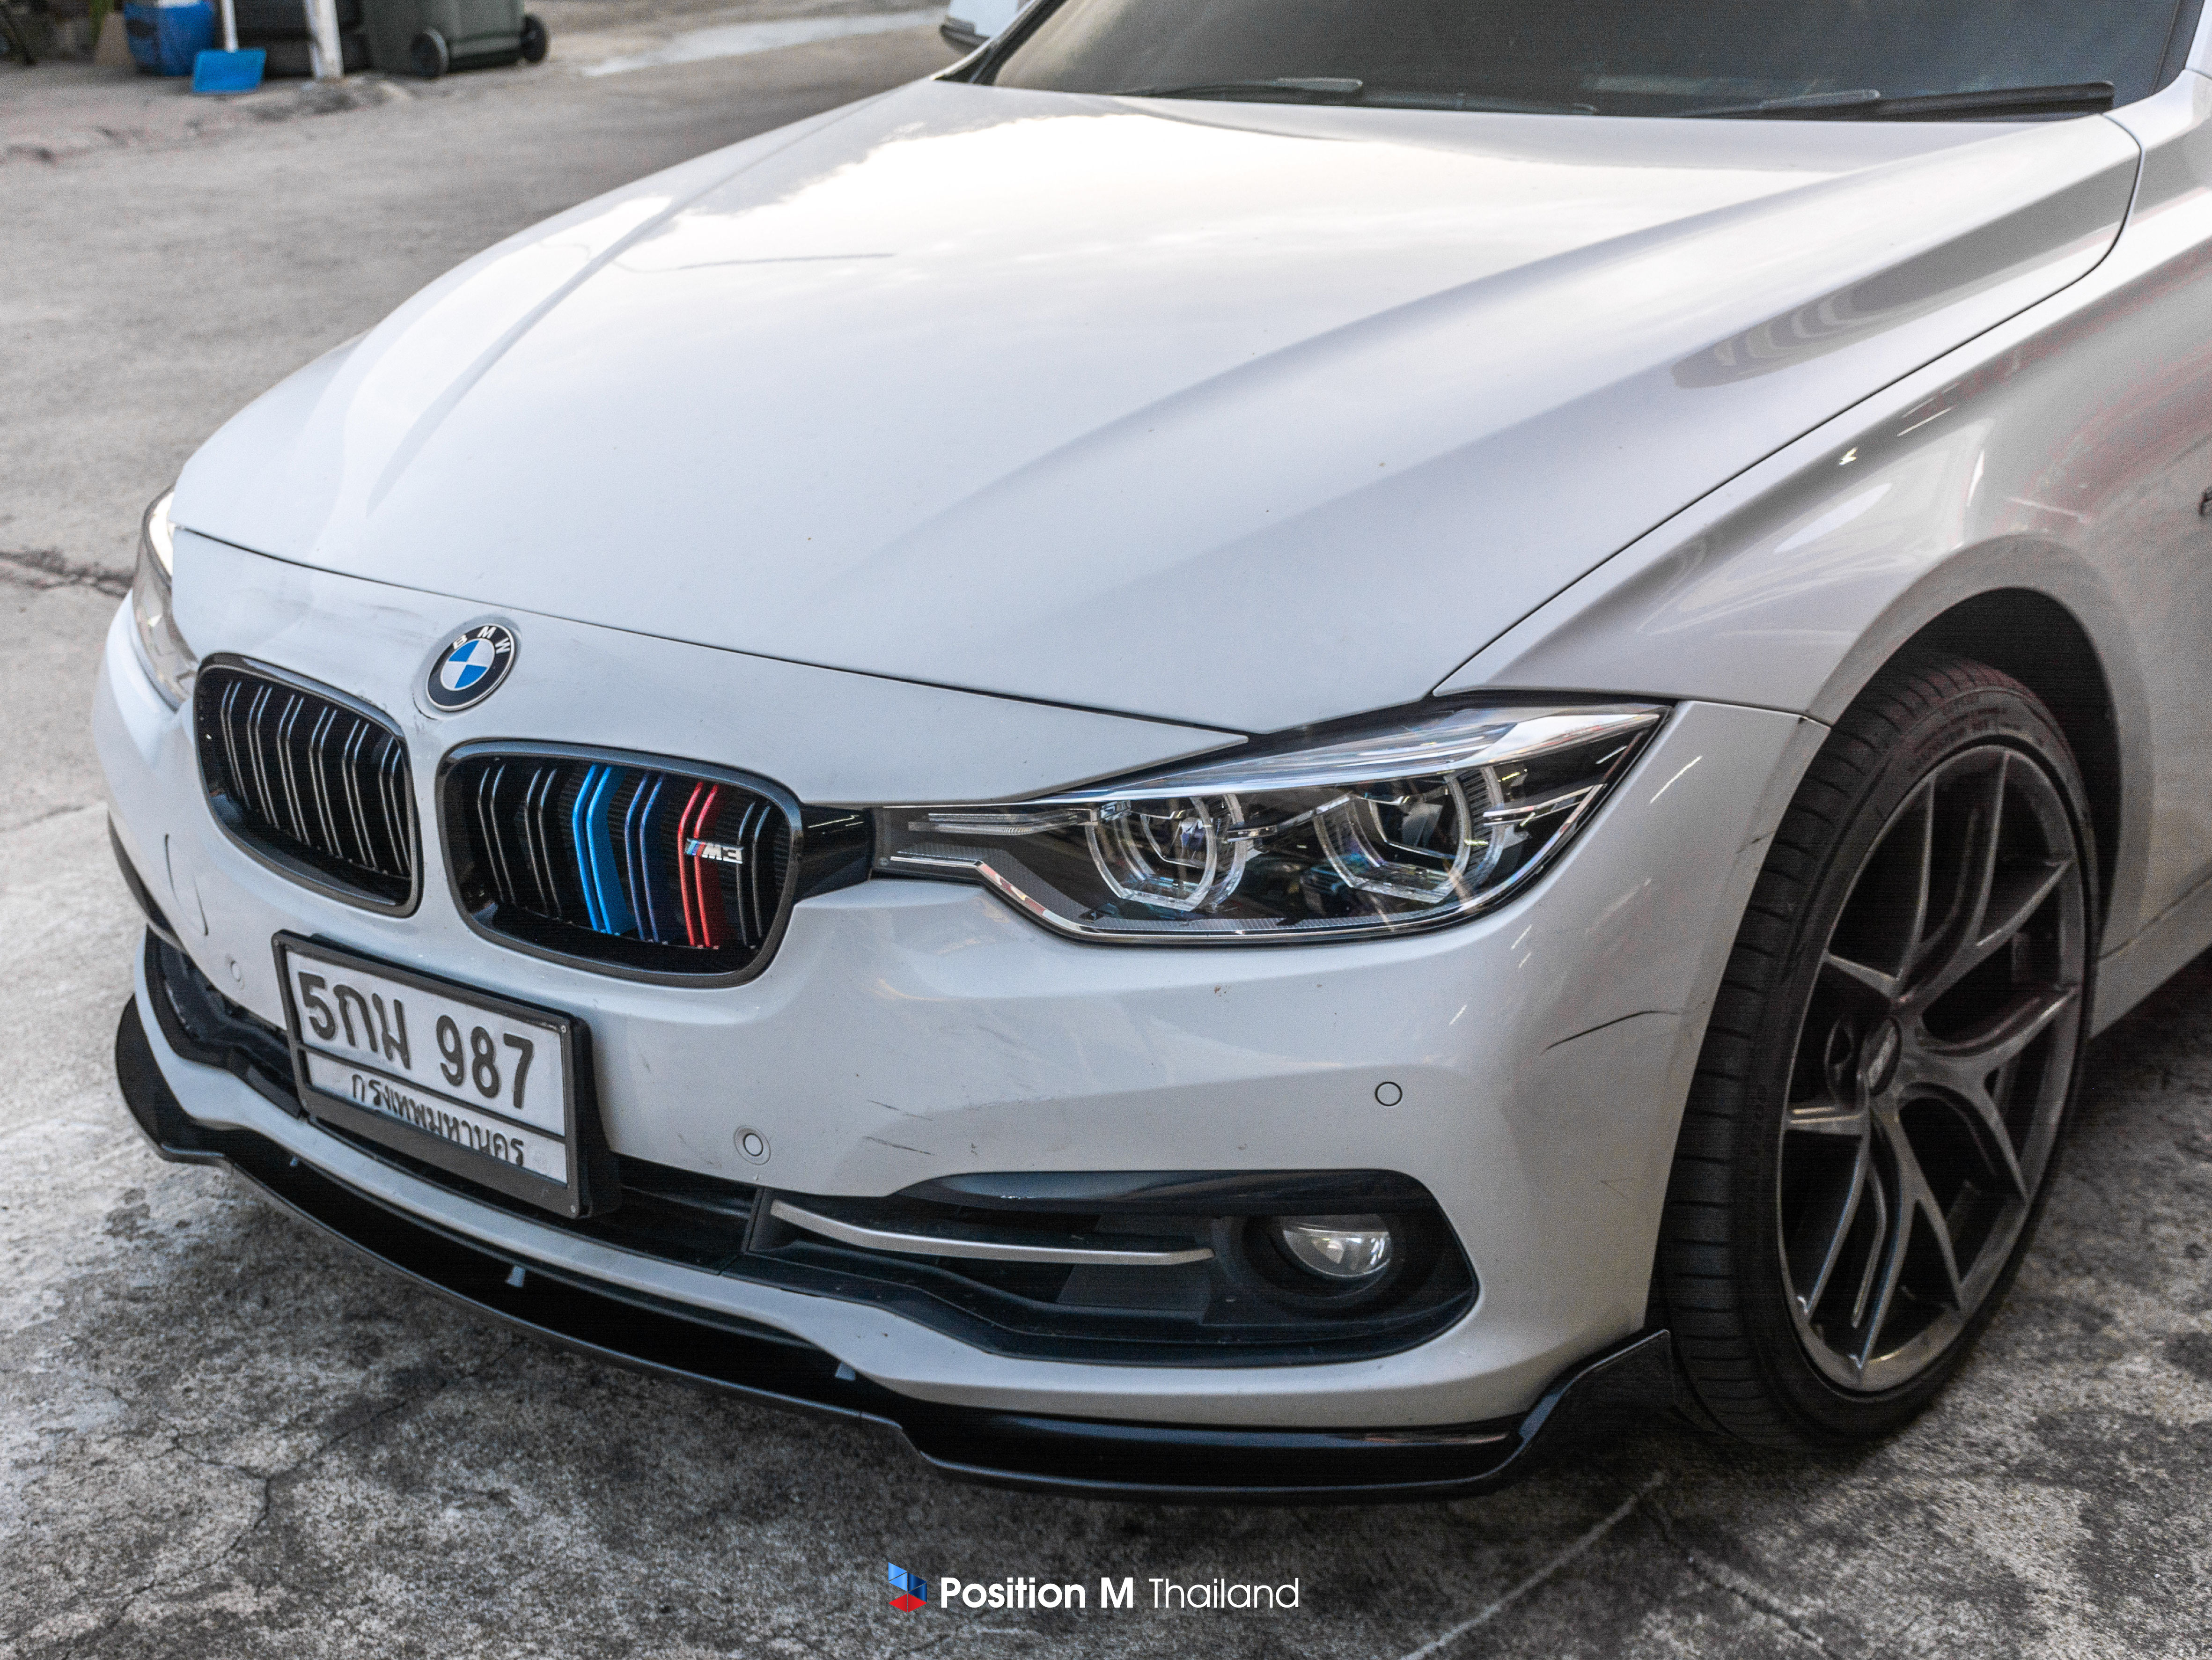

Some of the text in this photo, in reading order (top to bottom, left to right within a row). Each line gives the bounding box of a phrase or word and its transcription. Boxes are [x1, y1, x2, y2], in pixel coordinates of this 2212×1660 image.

[453, 626, 511, 654] BMW
[701, 842, 743, 864] M3
[436, 1015, 533, 1109] 987
[352, 1074, 524, 1166] กรงเทพมหานคร
